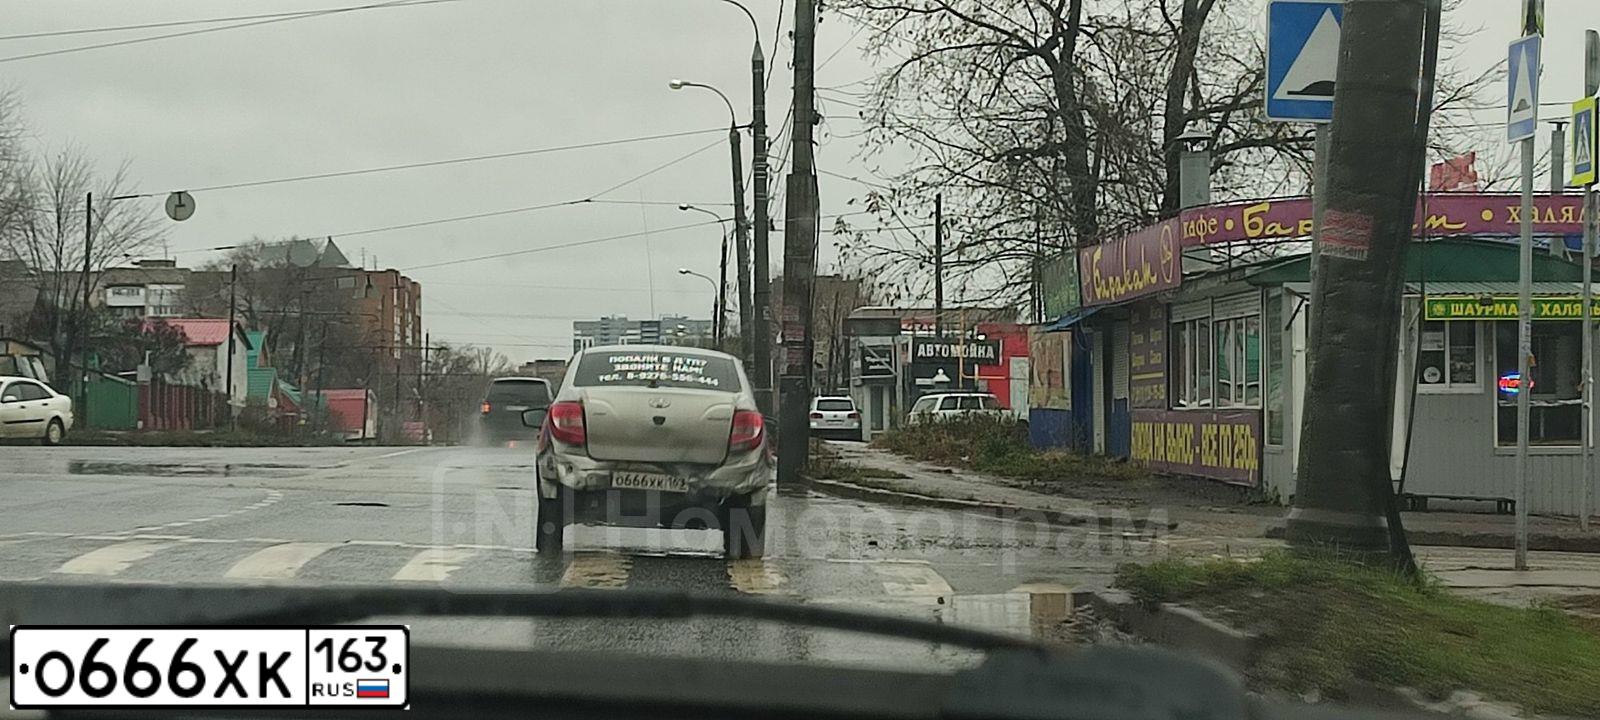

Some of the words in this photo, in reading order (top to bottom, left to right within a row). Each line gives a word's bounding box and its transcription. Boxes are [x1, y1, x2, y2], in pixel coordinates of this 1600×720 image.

[1183, 214, 1218, 243] кафе
[1451, 303, 1518, 316] ШАУРМА
[1541, 303, 1600, 316] ХАЛЯЬ
[917, 342, 995, 359] АВТОМОЙКА
[609, 355, 658, 363] ПОПАЛИ
[614, 363, 668, 371] ЗВОНИТЕ
[1154, 423, 1165, 461] НА
[1167, 423, 1194, 465] ВЫНОС
[1219, 424, 1232, 468] ПО
